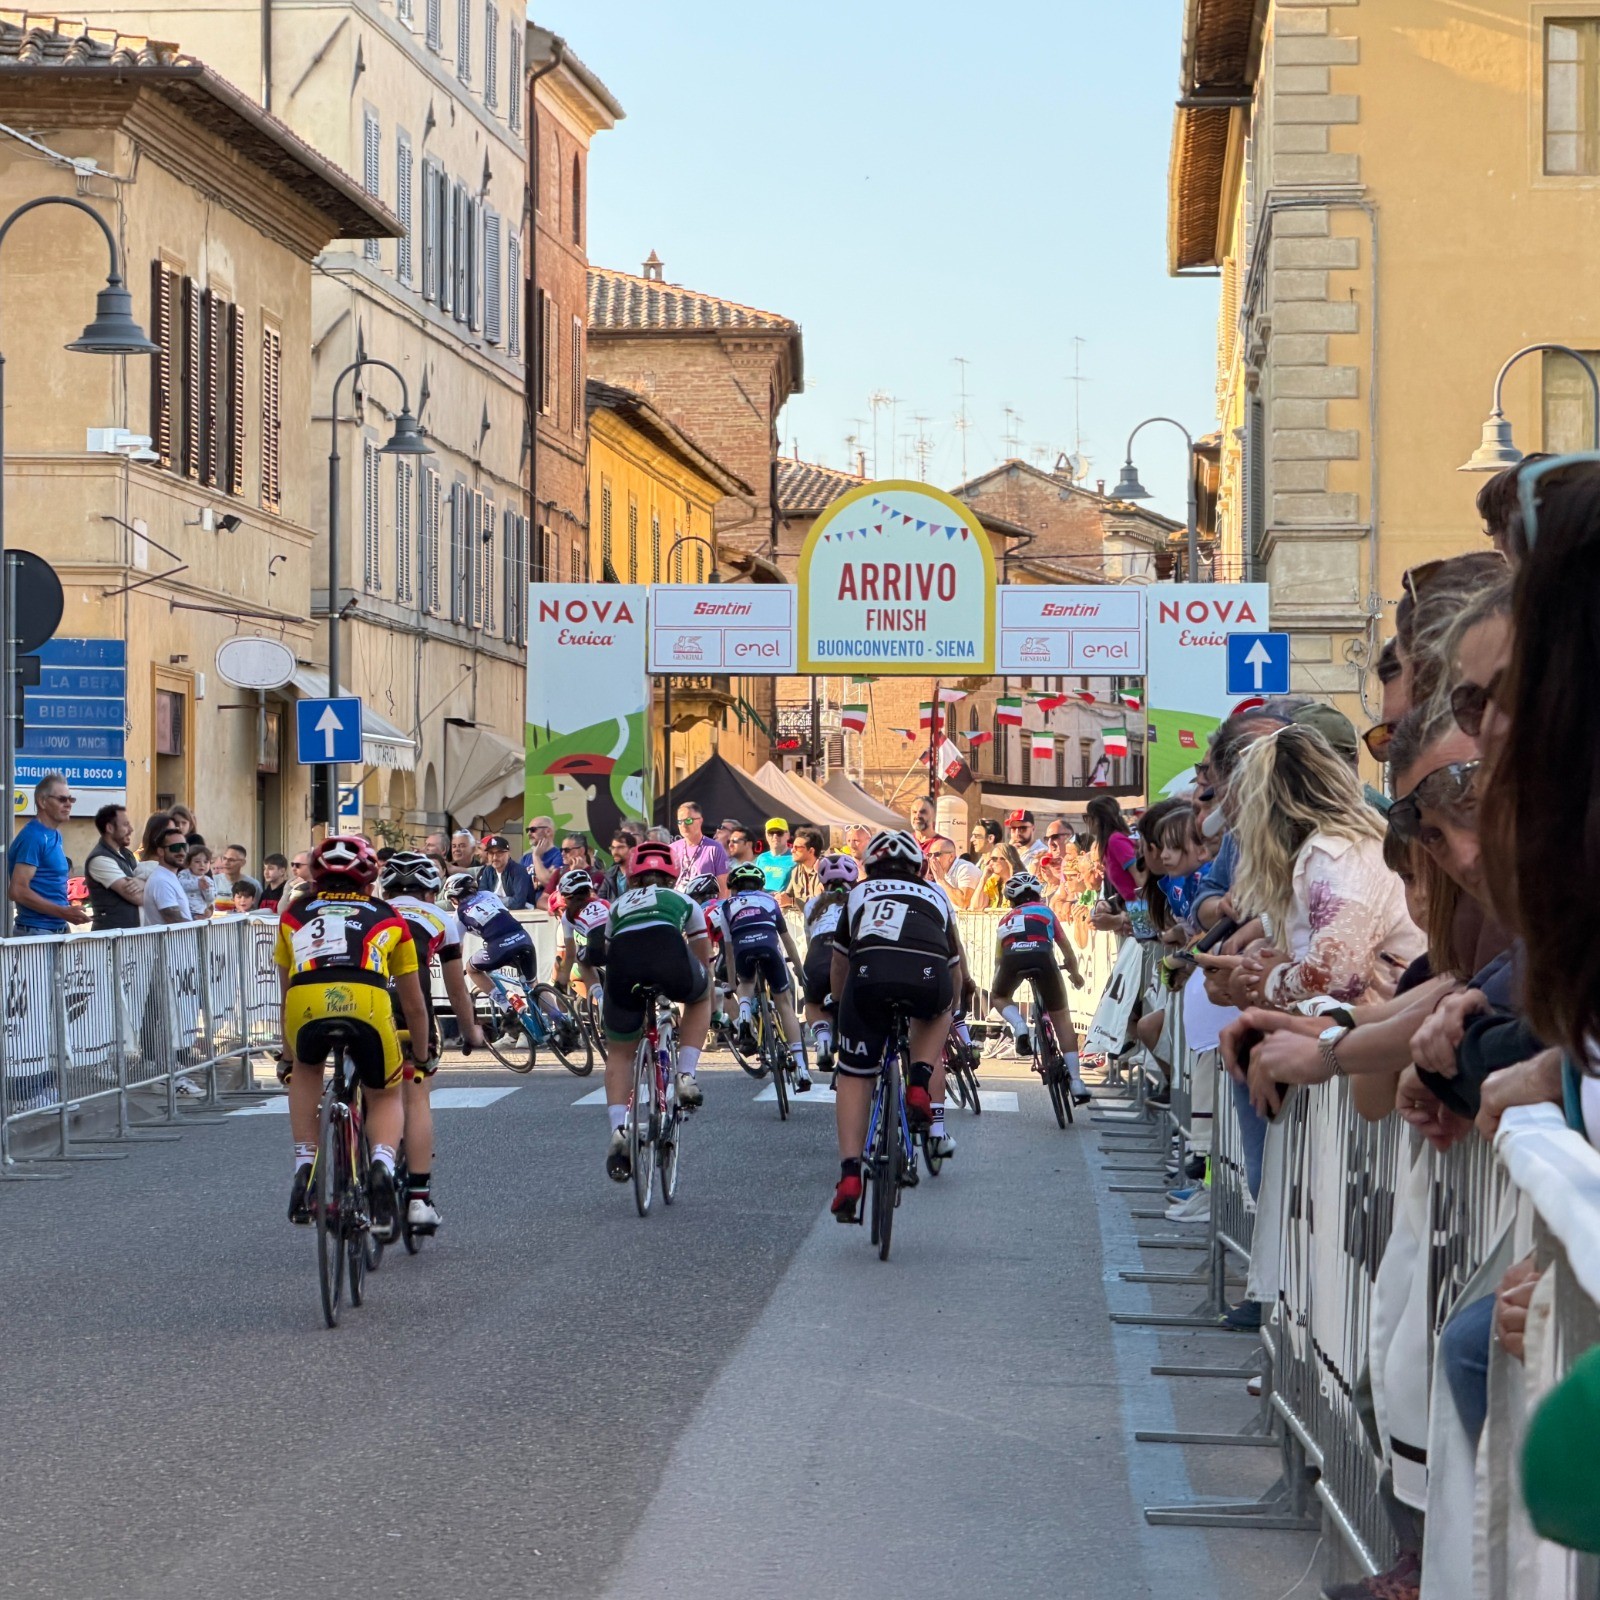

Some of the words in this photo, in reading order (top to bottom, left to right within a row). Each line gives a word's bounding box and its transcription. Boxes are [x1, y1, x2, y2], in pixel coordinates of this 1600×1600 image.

[838, 563, 956, 602] ARRIVO
[539, 600, 634, 623] NOVA
[693, 602, 752, 615] Santini
[1041, 603, 1101, 617] Santini
[1159, 600, 1257, 623] NOVA
[866, 609, 926, 631] FINISH
[557, 629, 613, 646] Eroica
[734, 640, 780, 657] enel
[817, 640, 924, 656] BUONCONVENTO
[935, 641, 975, 657] SIENA
[1082, 641, 1129, 658] enel
[50, 675, 70, 688] LA
[79, 675, 120, 689] BEFA
[39, 705, 121, 719] BIBBIANO
[66, 768, 81, 778] DEL
[83, 769, 114, 779] BOSCO
[117, 770, 122, 778] 9
[863, 884, 938, 905] AQUILA
[583, 904, 600, 916] 22
[872, 901, 896, 920] 15
[311, 918, 325, 939] 3
